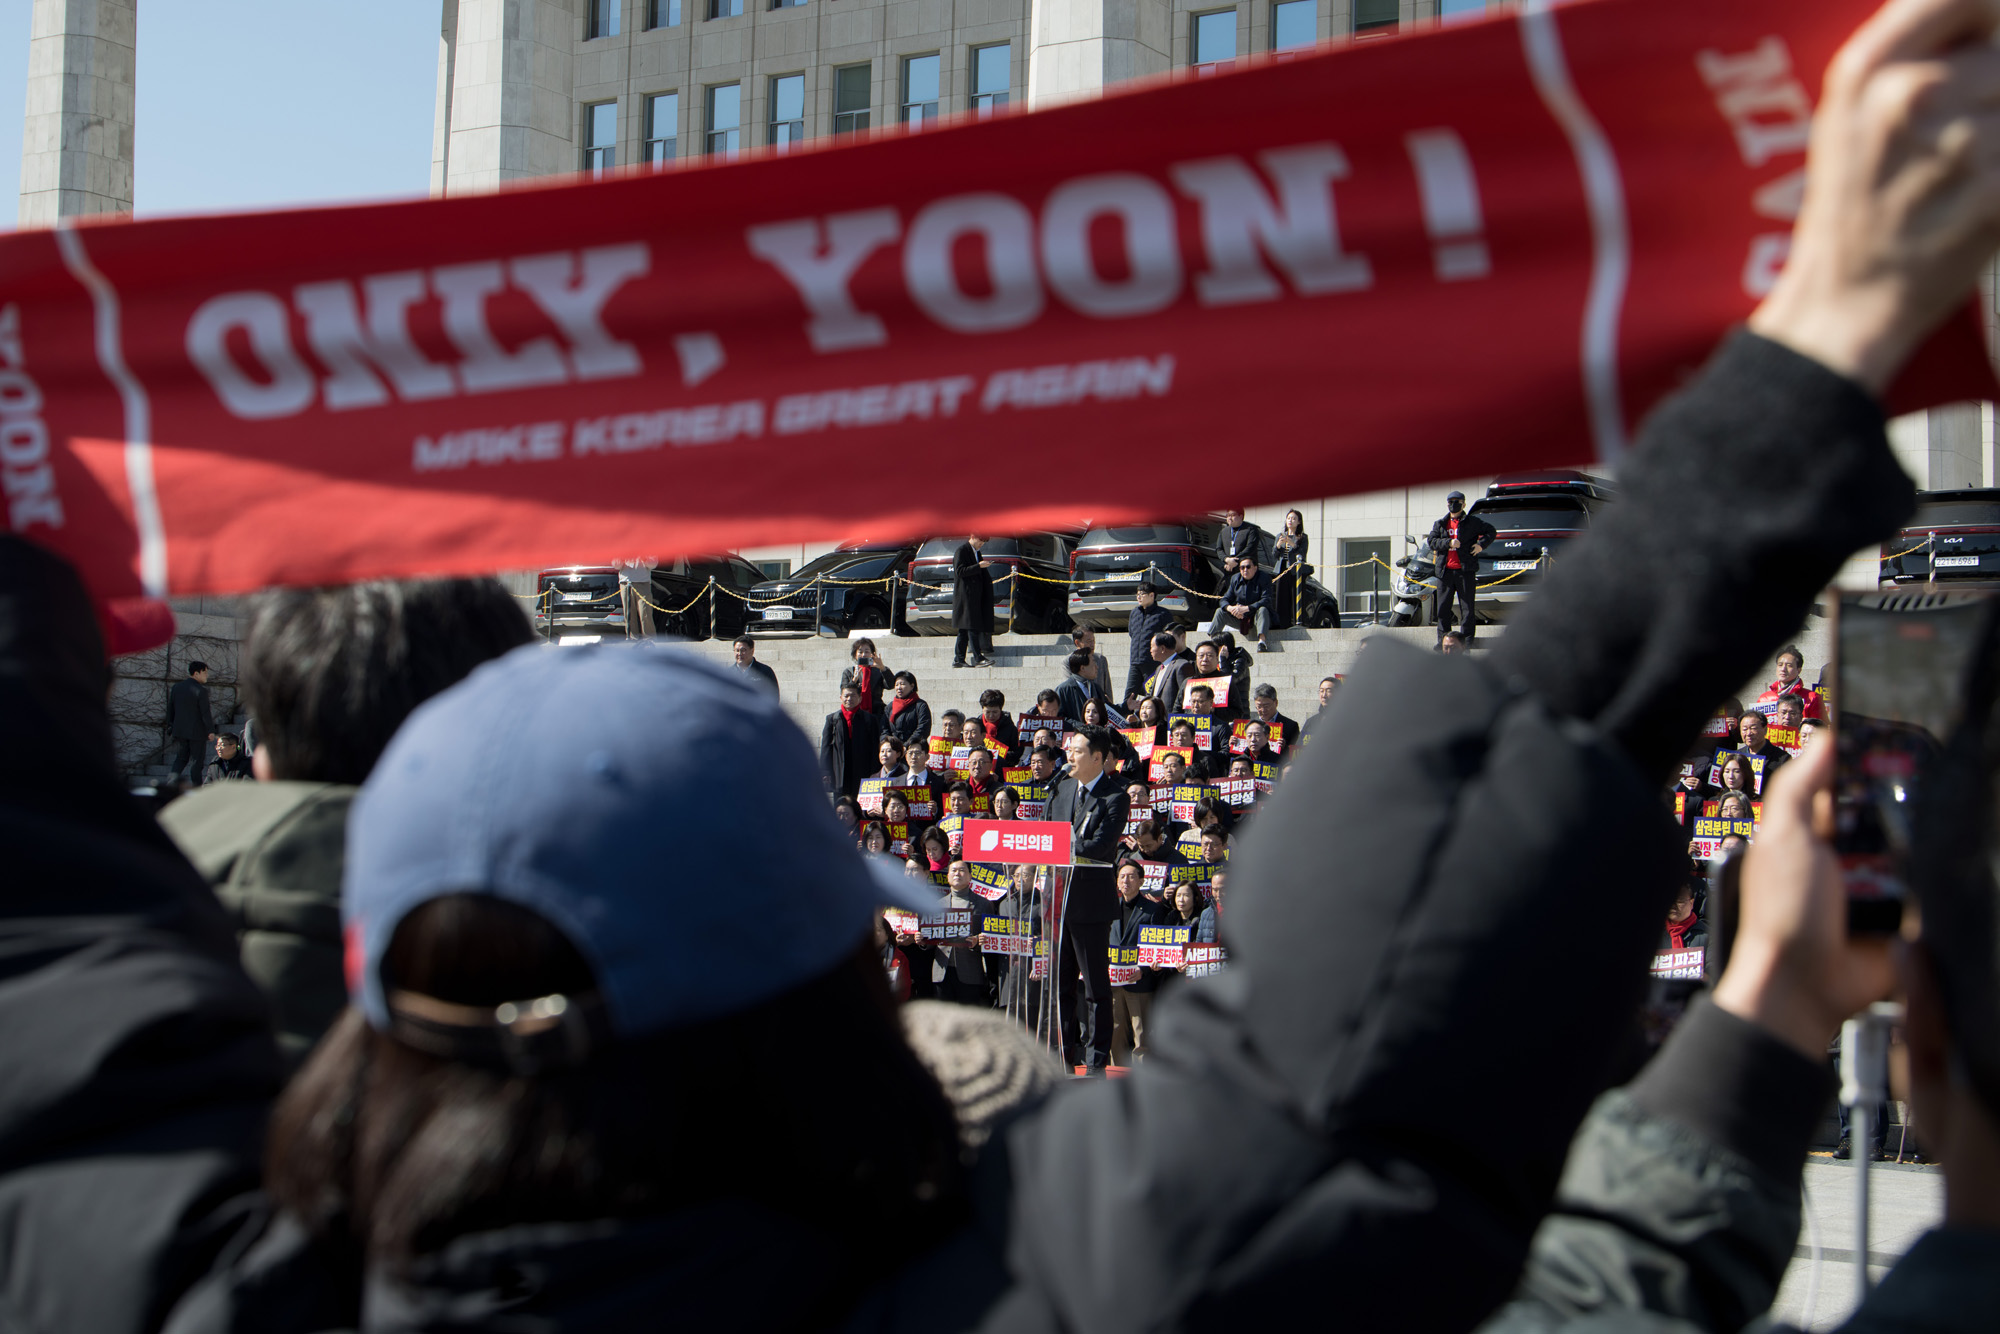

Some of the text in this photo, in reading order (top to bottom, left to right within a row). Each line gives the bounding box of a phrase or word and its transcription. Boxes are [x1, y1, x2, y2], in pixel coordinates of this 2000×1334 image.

[413, 354, 1177, 473] MAKE KOREA GREAT AGAIN
[1020, 718, 1063, 730] 사법 파괴
[1197, 717, 1211, 730] 파괴
[1261, 765, 1279, 780] 파괴
[1751, 757, 1765, 774] 파괴
[1174, 786, 1202, 802] 삼권분립
[1231, 779, 1254, 793] 파괴
[917, 788, 930, 802] 3법
[974, 795, 988, 810] 3법
[1231, 791, 1254, 806] 완성
[1130, 807, 1153, 820] 파괴
[1173, 805, 1187, 820] 당장
[893, 824, 907, 839] 3법
[1695, 820, 1752, 838] 삼권분립 파괴
[1002, 834, 1053, 851] 국민의힘
[1179, 843, 1202, 860] 삼권분
[971, 863, 996, 884] 권분립
[1143, 864, 1167, 877] 파괴
[1170, 866, 1205, 882] 삼권분립
[946, 911, 971, 924] 파괴
[983, 916, 1016, 933] 삼권분립
[920, 924, 971, 940] 독재 완성
[1140, 926, 1190, 944] 삼권분립 파괴
[984, 935, 999, 951] 당장
[1120, 948, 1139, 964] 파괴
[1138, 947, 1155, 963] 당장
[1186, 947, 1208, 963] 사법
[1674, 950, 1702, 967] 파괴
